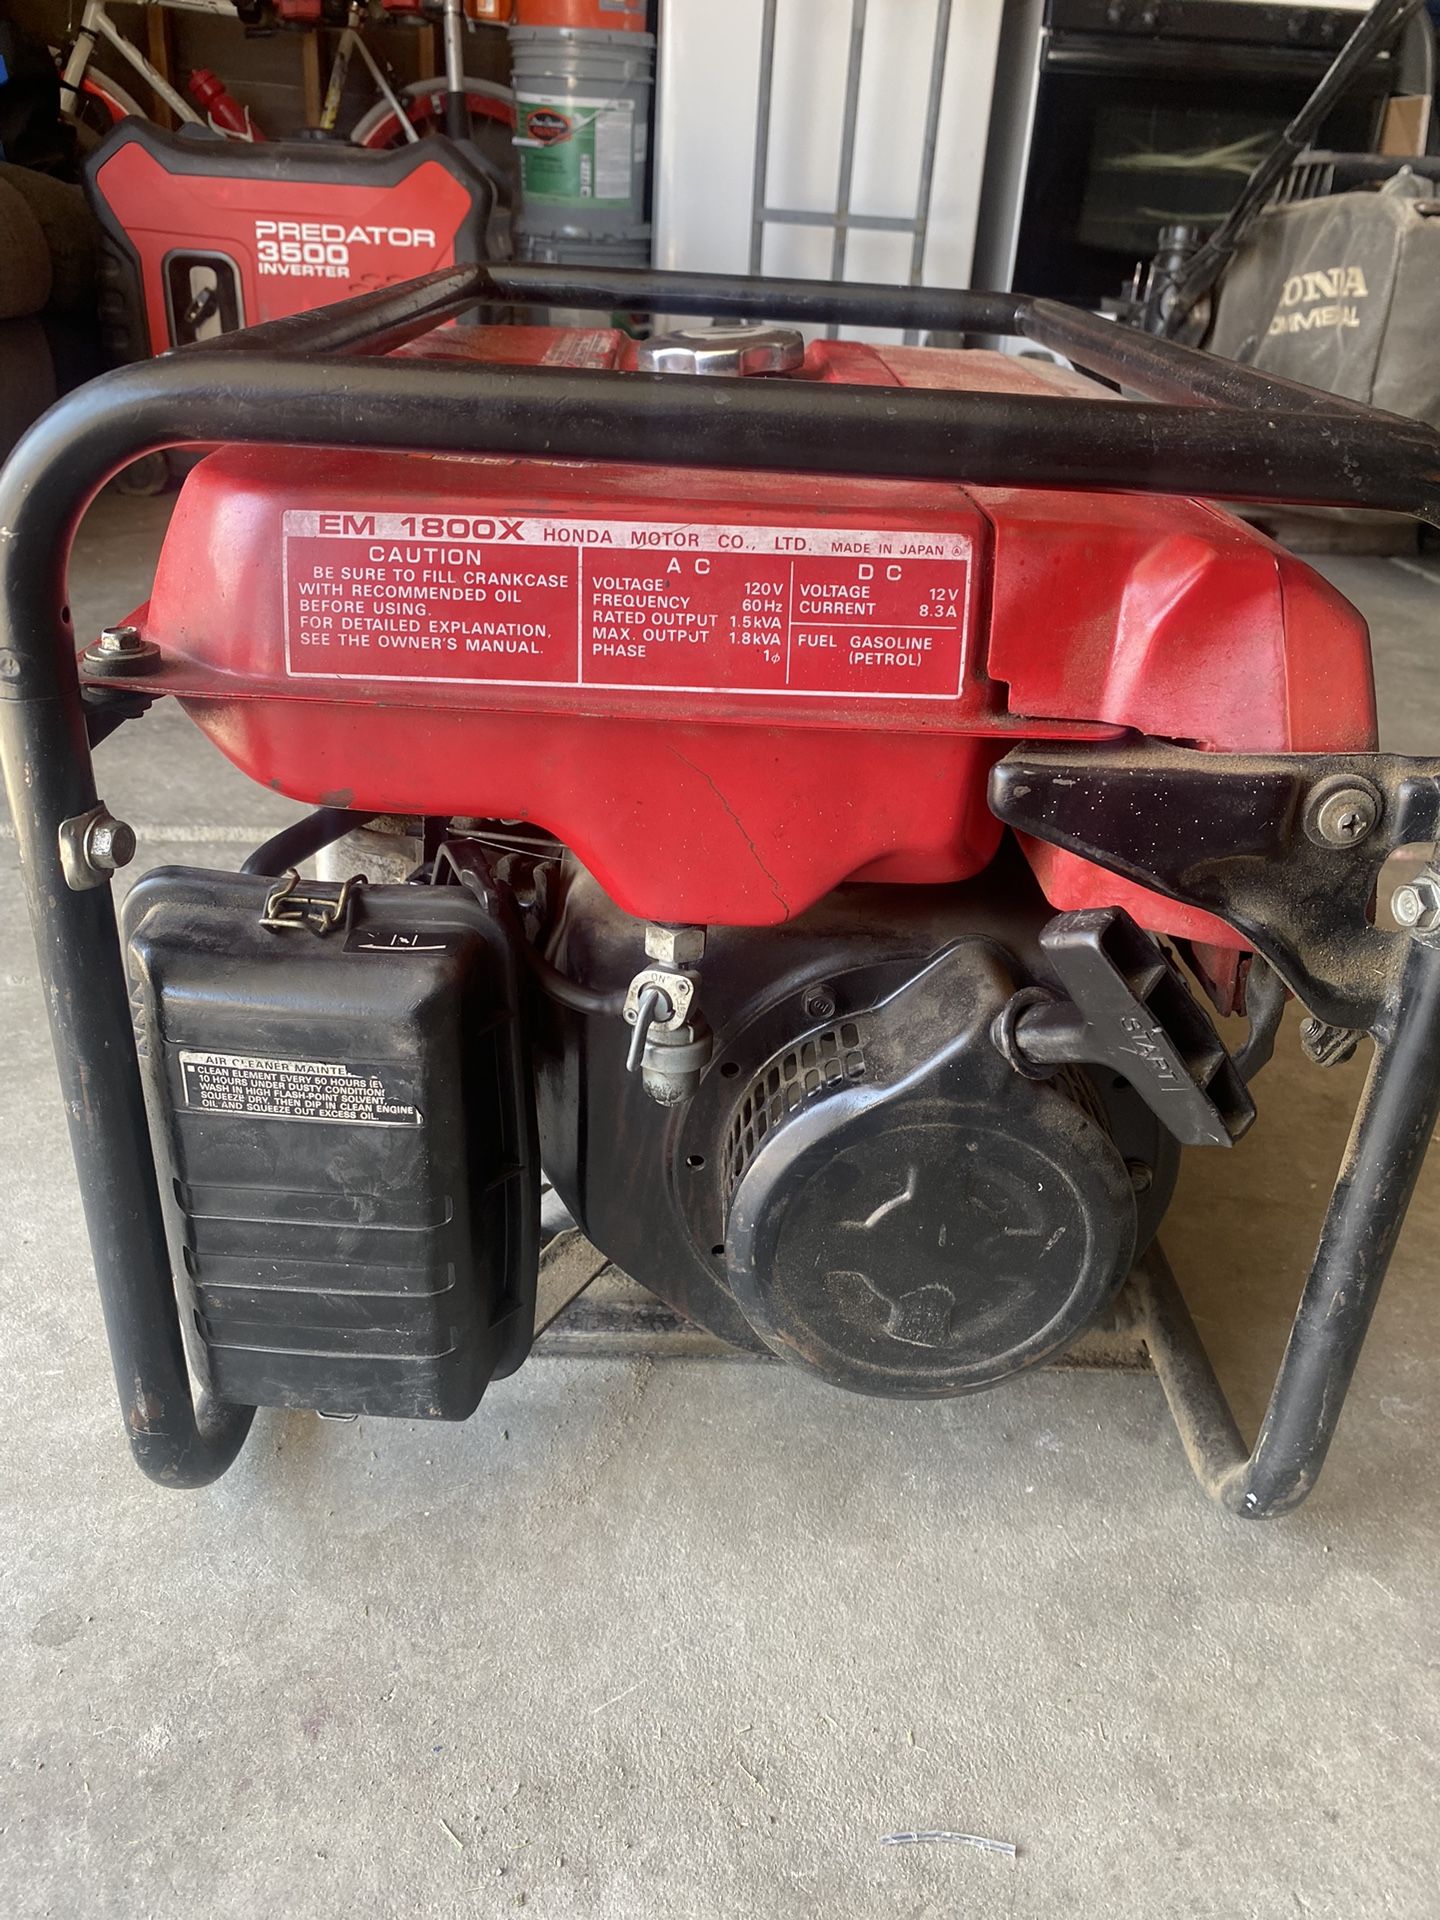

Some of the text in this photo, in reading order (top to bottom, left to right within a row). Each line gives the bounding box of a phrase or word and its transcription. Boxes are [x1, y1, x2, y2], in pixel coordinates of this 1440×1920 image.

[255, 221, 435, 247] PREDATOR
[257, 241, 349, 265] 3500
[258, 263, 350, 278] INVERTER
[319, 514, 524, 541] EM 1800X
[544, 528, 812, 552] HONDA MOTOR CO., LTD.
[369, 546, 481, 565] CAUTION
[831, 542, 870, 553] MADE
[879, 544, 892, 554] IN
[900, 545, 944, 556] JAPAN
[313, 566, 568, 588] BE SURE TO FILL CRANKCASE
[593, 577, 664, 592] VOLTAGE
[299, 583, 522, 603] WITH RECOMMENDED OIL
[800, 584, 870, 599] VOLTAGE
[300, 599, 432, 616] BEFORE USING.
[593, 594, 690, 609] FREQUENCY
[799, 601, 876, 616] CURRENT
[300, 616, 551, 638] FOR DETAILED EXPLANATION,
[593, 610, 646, 625] RATED
[651, 612, 718, 627] OUTPUT
[300, 632, 544, 654] SEE THE OWNER'S MANUAL.
[593, 627, 636, 641] MAX.
[643, 628, 709, 643] OUTPUT
[798, 634, 933, 651] FUEL GASOLINE
[593, 643, 646, 658] PHASE
[849, 652, 921, 667] (PETROL)
[206, 1056, 227, 1065] AIR
[197, 1066, 229, 1076] CLEAN
[232, 1069, 277, 1080] ELEMENT
[280, 1074, 312, 1083] EVERY
[330, 1078, 366, 1087] HOURS
[213, 1076, 248, 1086] HOURS
[251, 1079, 285, 1089] UNDER
[288, 1083, 322, 1092] DUSTY
[200, 1083, 229, 1092] WASH
[232, 1086, 243, 1094] IN
[246, 1087, 271, 1096] HIGH
[274, 1090, 338, 1101] FLASH-POINT
[201, 1091, 245, 1102] SQUEEZE
[274, 1098, 301, 1106] THEN
[305, 1100, 322, 1108] DIP
[340, 1103, 372, 1112] CLEAN
[376, 1105, 414, 1114] ENGINE
[202, 1100, 379, 1120] OIL AND SQUEEZE OUT EXCESS OIL.
